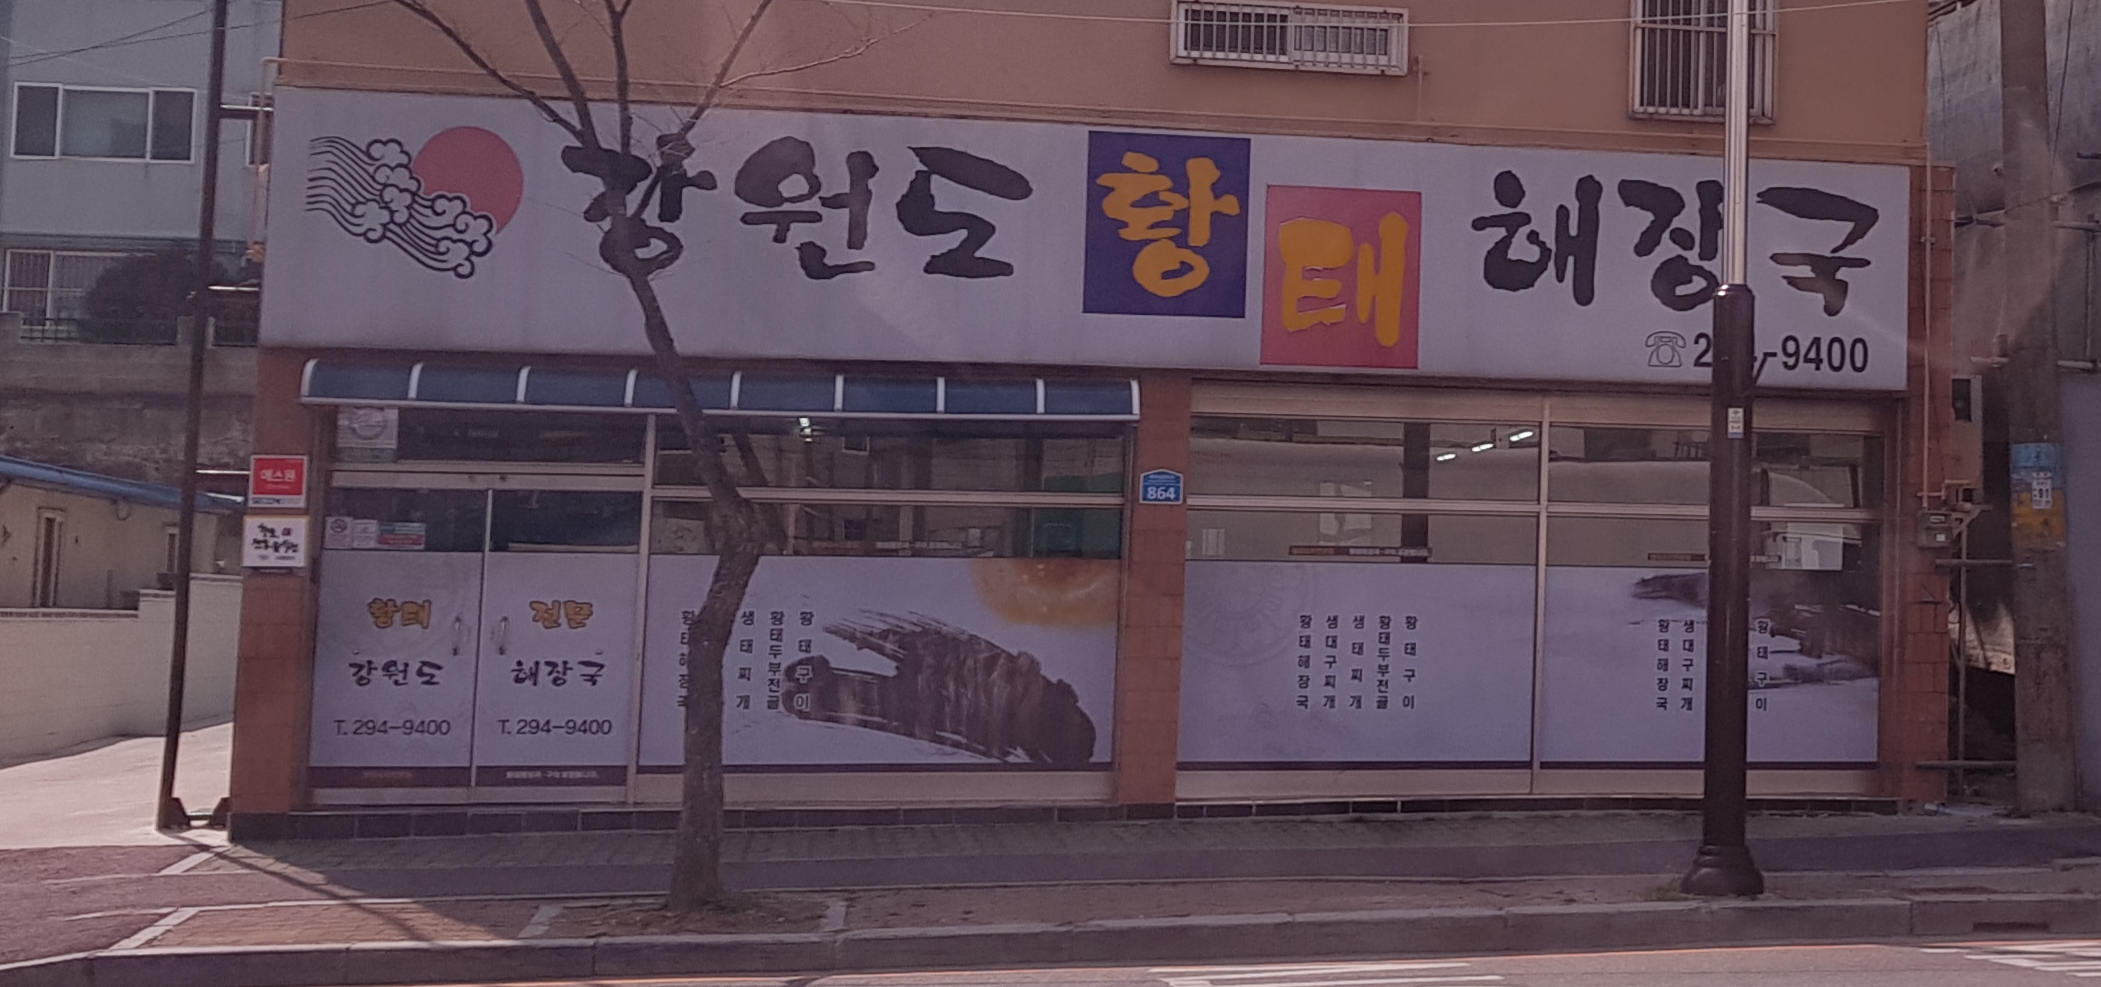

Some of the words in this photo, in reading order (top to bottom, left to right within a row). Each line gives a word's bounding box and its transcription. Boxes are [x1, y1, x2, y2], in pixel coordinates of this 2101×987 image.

[561, 136, 1033, 280] 강원도
[1471, 170, 1879, 317] 해장국
[1693, 334, 1869, 373] 2-9400
[1147, 486, 1175, 500] 864
[367, 598, 432, 628] 황태
[529, 600, 593, 629] 전문
[348, 659, 444, 687] 강원도
[510, 659, 605, 687] 해장국
[736, 611, 755, 709] 생태찌개
[766, 611, 784, 709] 황태두부전골
[795, 611, 814, 711] 황태구이
[1296, 614, 1313, 710] 황태해장국
[1323, 614, 1340, 709] 생대구찌개
[1349, 614, 1366, 710] 생태찌개
[1376, 615, 1392, 710] 황태두부전골
[1402, 615, 1418, 710] 황태구이
[1656, 618, 1670, 711] 황태해장국
[1680, 618, 1695, 712] 생대구찌개
[1755, 619, 1770, 712] 황태구이
[352, 719, 451, 736] 294-9400
[516, 719, 612, 735] 294-9400
